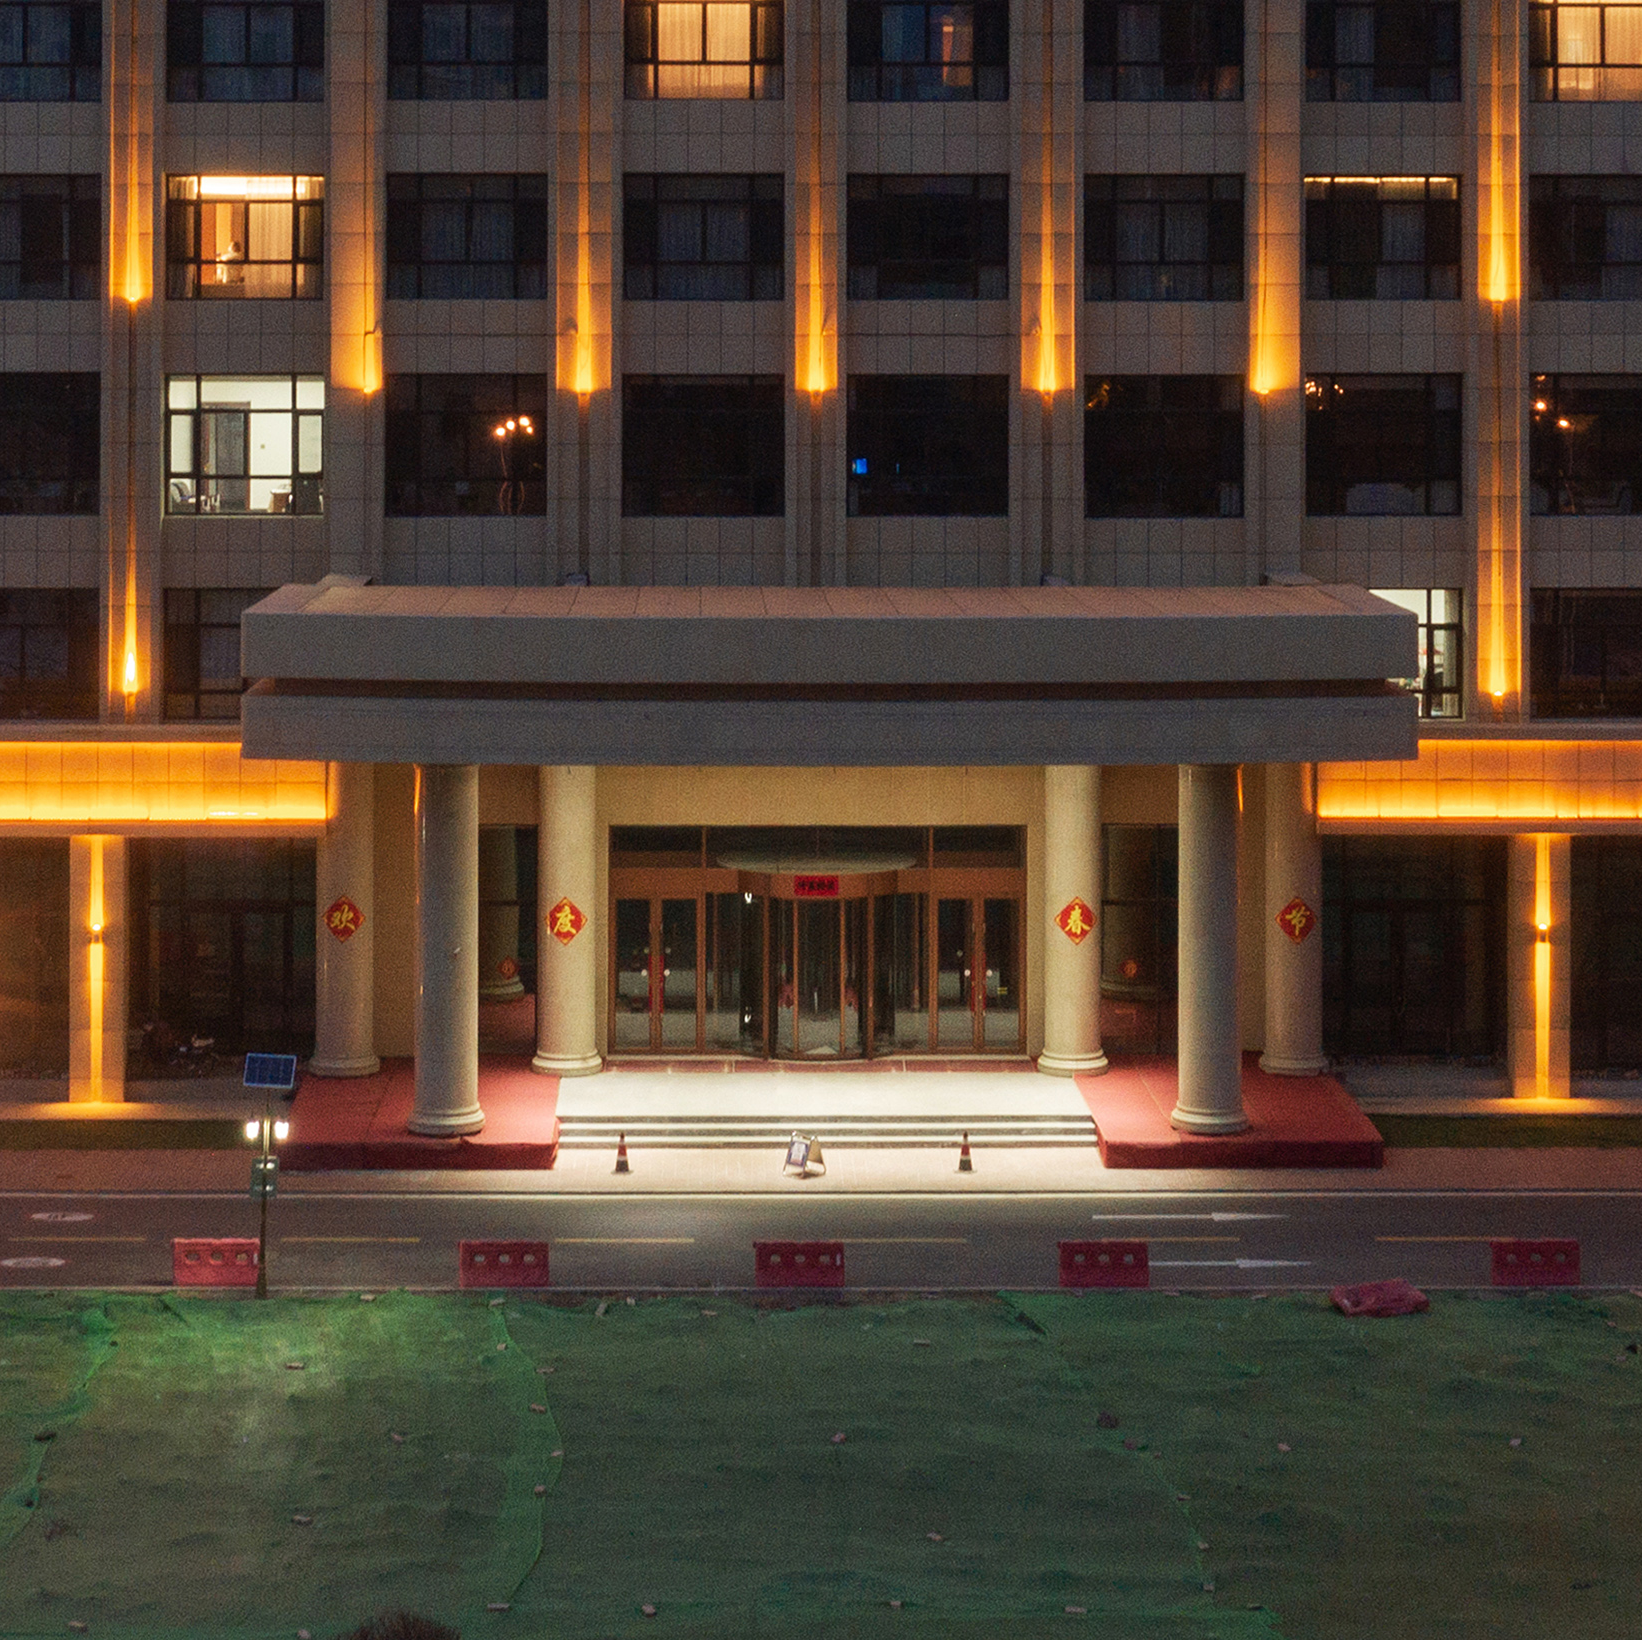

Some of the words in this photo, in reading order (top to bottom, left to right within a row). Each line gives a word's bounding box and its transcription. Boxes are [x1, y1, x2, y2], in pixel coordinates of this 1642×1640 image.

[331, 905, 355, 930] 欢
[553, 906, 576, 934] 度
[1063, 905, 1090, 935] 春
[1286, 906, 1310, 936] 节
